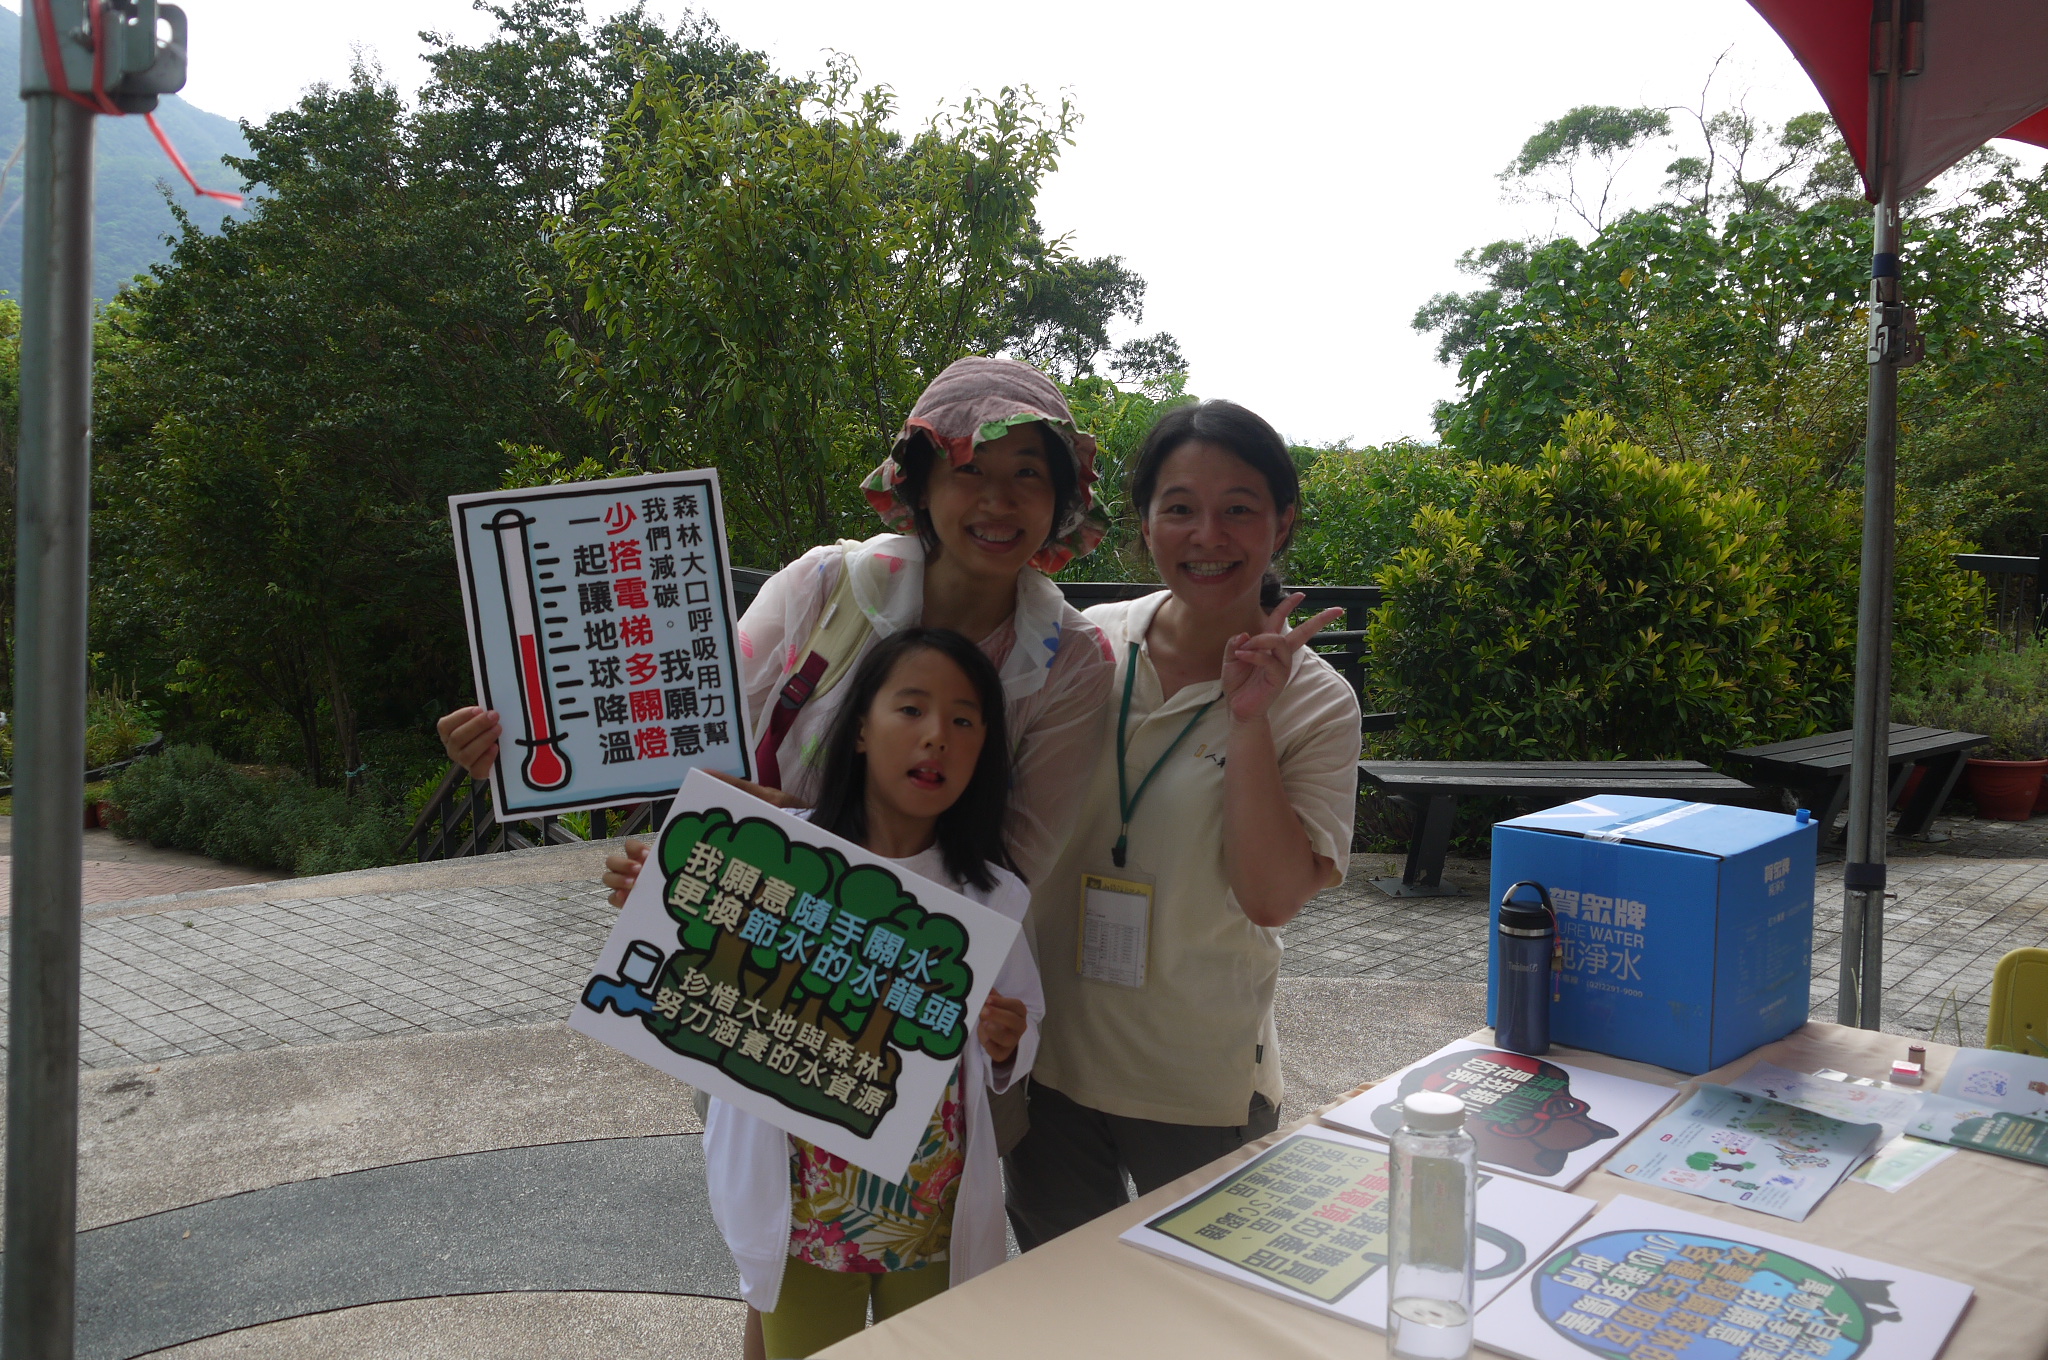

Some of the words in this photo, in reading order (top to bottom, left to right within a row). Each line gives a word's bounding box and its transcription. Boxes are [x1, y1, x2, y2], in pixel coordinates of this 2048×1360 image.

[568, 516, 636, 766] 一起讓地球降溫
[603, 501, 670, 761] 少搭電梯多關燈
[673, 494, 730, 747] 森林大口呼吸用力幫
[668, 873, 964, 1039] 更換節水的水龍頭
[683, 841, 940, 985] 我願意隨手關水
[1557, 920, 1586, 938] URE
[1590, 925, 1645, 949] WATER
[650, 985, 887, 1117] 努力涵養的水資源
[678, 967, 884, 1082] 珍惜大地與森林
[1481, 1074, 1569, 1124] 無痕山林
[1224, 1141, 1320, 1199] 的森林產品
[1552, 1252, 1616, 1291] 他們
[1555, 1234, 1681, 1336] 小心避免傷害
[1595, 1243, 1722, 1349] 各種生物朋友
[1705, 1289, 1783, 1347] 我願意
